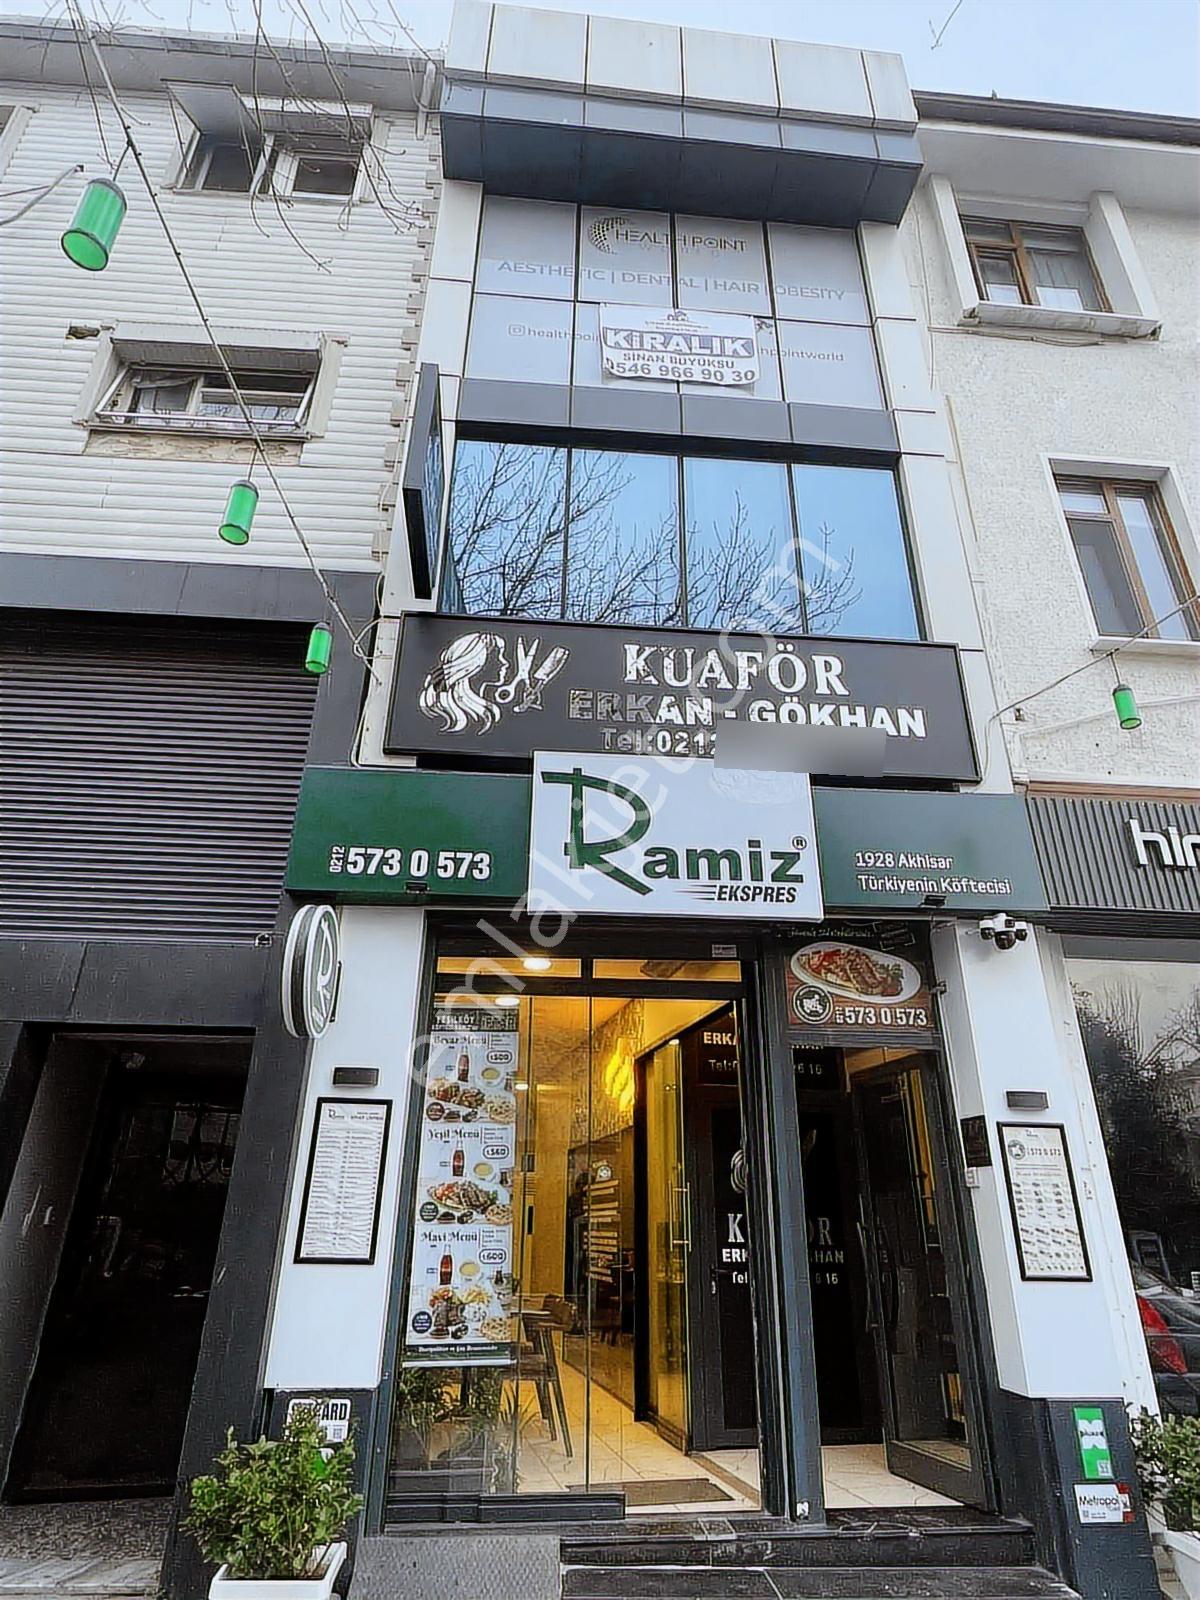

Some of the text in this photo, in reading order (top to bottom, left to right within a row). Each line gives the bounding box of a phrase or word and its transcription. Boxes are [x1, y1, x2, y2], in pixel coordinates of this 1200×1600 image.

[713, 279, 760, 295] HAIR
[775, 285, 845, 300] OBESITY
[659, 365, 694, 379] 966
[701, 368, 724, 382] 90
[732, 370, 756, 383] 30
[623, 642, 850, 695] KUAFÖR
[568, 688, 713, 726] ERKAN
[749, 695, 927, 738] GÖKHAN
[346, 847, 402, 876] 573
[409, 849, 429, 877] 0
[436, 851, 491, 880] 573
[855, 852, 895, 868] 1928
[716, 885, 797, 904] EKSPRES
[858, 874, 1012, 895] Türkiyenin Köftecisi
[845, 1006, 877, 1025] 573
[881, 1007, 892, 1025] 0
[896, 1008, 927, 1026] 573
